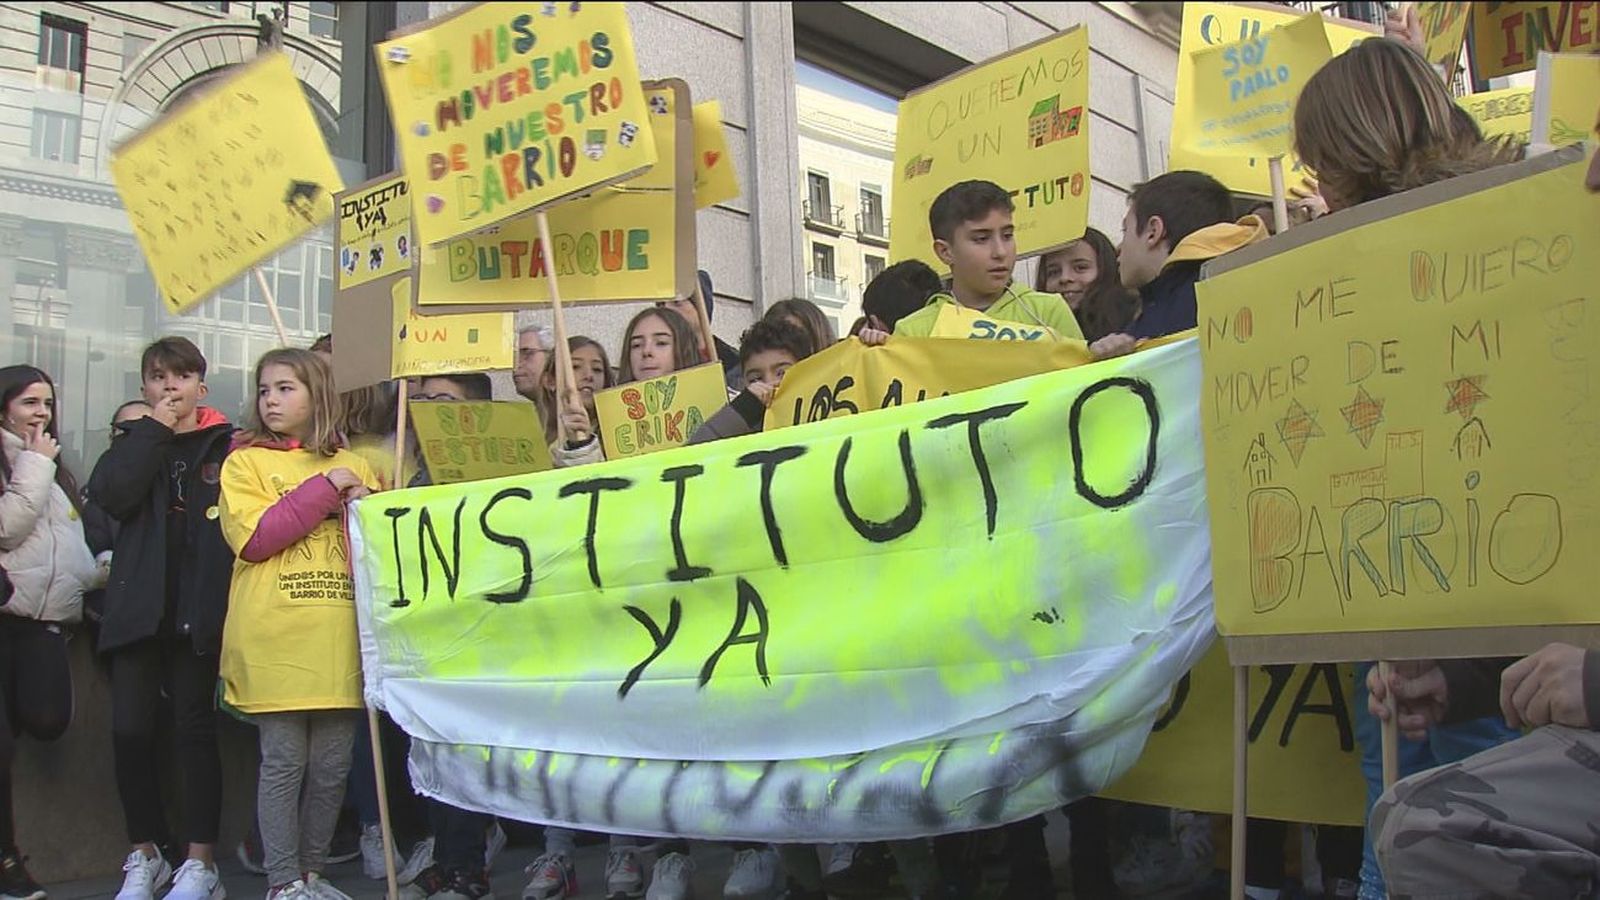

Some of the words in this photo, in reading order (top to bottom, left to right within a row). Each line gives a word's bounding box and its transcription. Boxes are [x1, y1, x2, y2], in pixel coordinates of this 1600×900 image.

[472, 14, 537, 74] NOS
[1501, 2, 1600, 68] INVE
[435, 32, 614, 131] MOVEREMOS
[926, 49, 1084, 141] QUEREMOS
[426, 144, 467, 180] DE
[484, 77, 624, 159] NUESTRO
[958, 126, 1001, 164] UN
[457, 136, 577, 221] BARRIO
[449, 229, 650, 282] BUTARQUE
[1207, 306, 1253, 350] NO
[1294, 276, 1357, 328] ME
[1410, 233, 1573, 303] QUIERO
[414, 327, 447, 343] UN
[621, 375, 677, 420] SOY
[1215, 355, 1310, 422] MOVER
[1347, 339, 1406, 385] DE
[1450, 319, 1502, 373] MI
[436, 403, 493, 436] SOY
[615, 406, 705, 454] ERIKA
[382, 377, 1162, 608] INSTITUTO
[279, 582, 293, 590] UN
[296, 580, 340, 589] INSTITUTO
[290, 590, 325, 599] BARRIO
[617, 577, 772, 700] YA
[1249, 663, 1355, 752] YA
